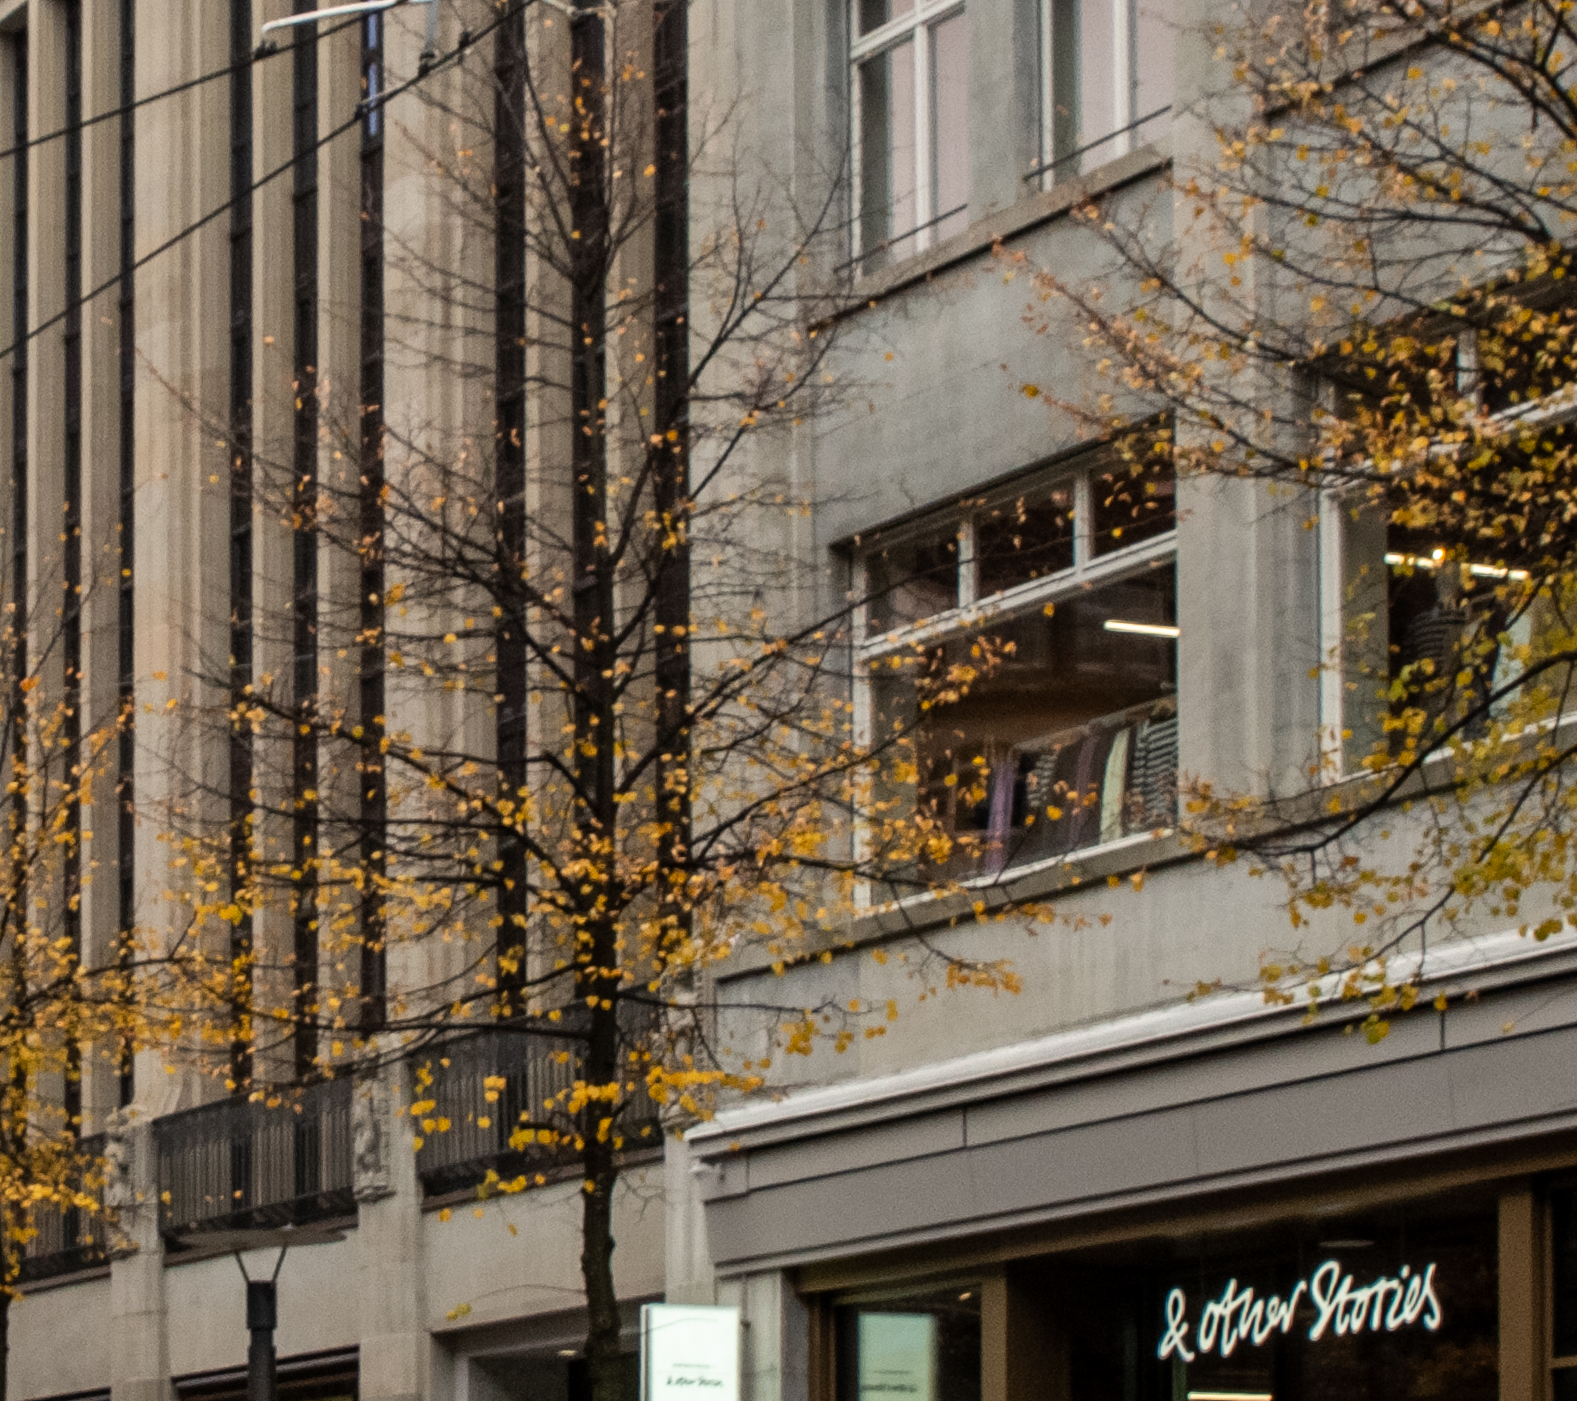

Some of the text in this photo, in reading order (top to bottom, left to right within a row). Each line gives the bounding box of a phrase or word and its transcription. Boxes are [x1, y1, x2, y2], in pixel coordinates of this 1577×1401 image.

[1157, 1258, 1442, 1361] & other Stories
